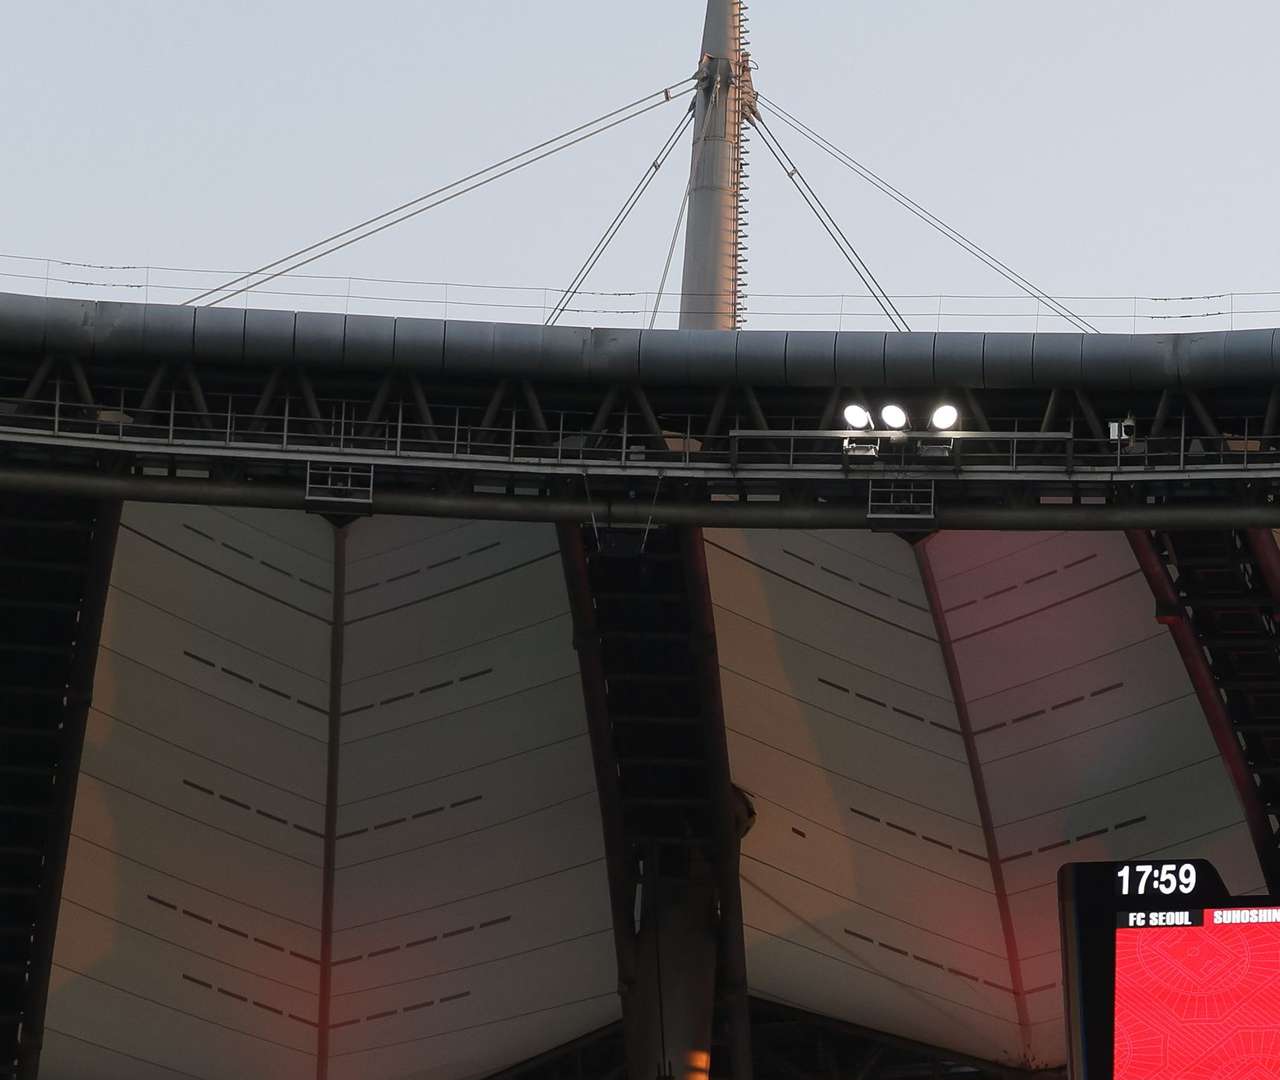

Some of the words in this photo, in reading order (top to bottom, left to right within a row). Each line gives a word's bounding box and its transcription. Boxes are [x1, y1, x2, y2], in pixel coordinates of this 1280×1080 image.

[1117, 863, 1198, 896] 17:59
[1129, 912, 1146, 926] FC
[1149, 911, 1192, 926] SEOUL
